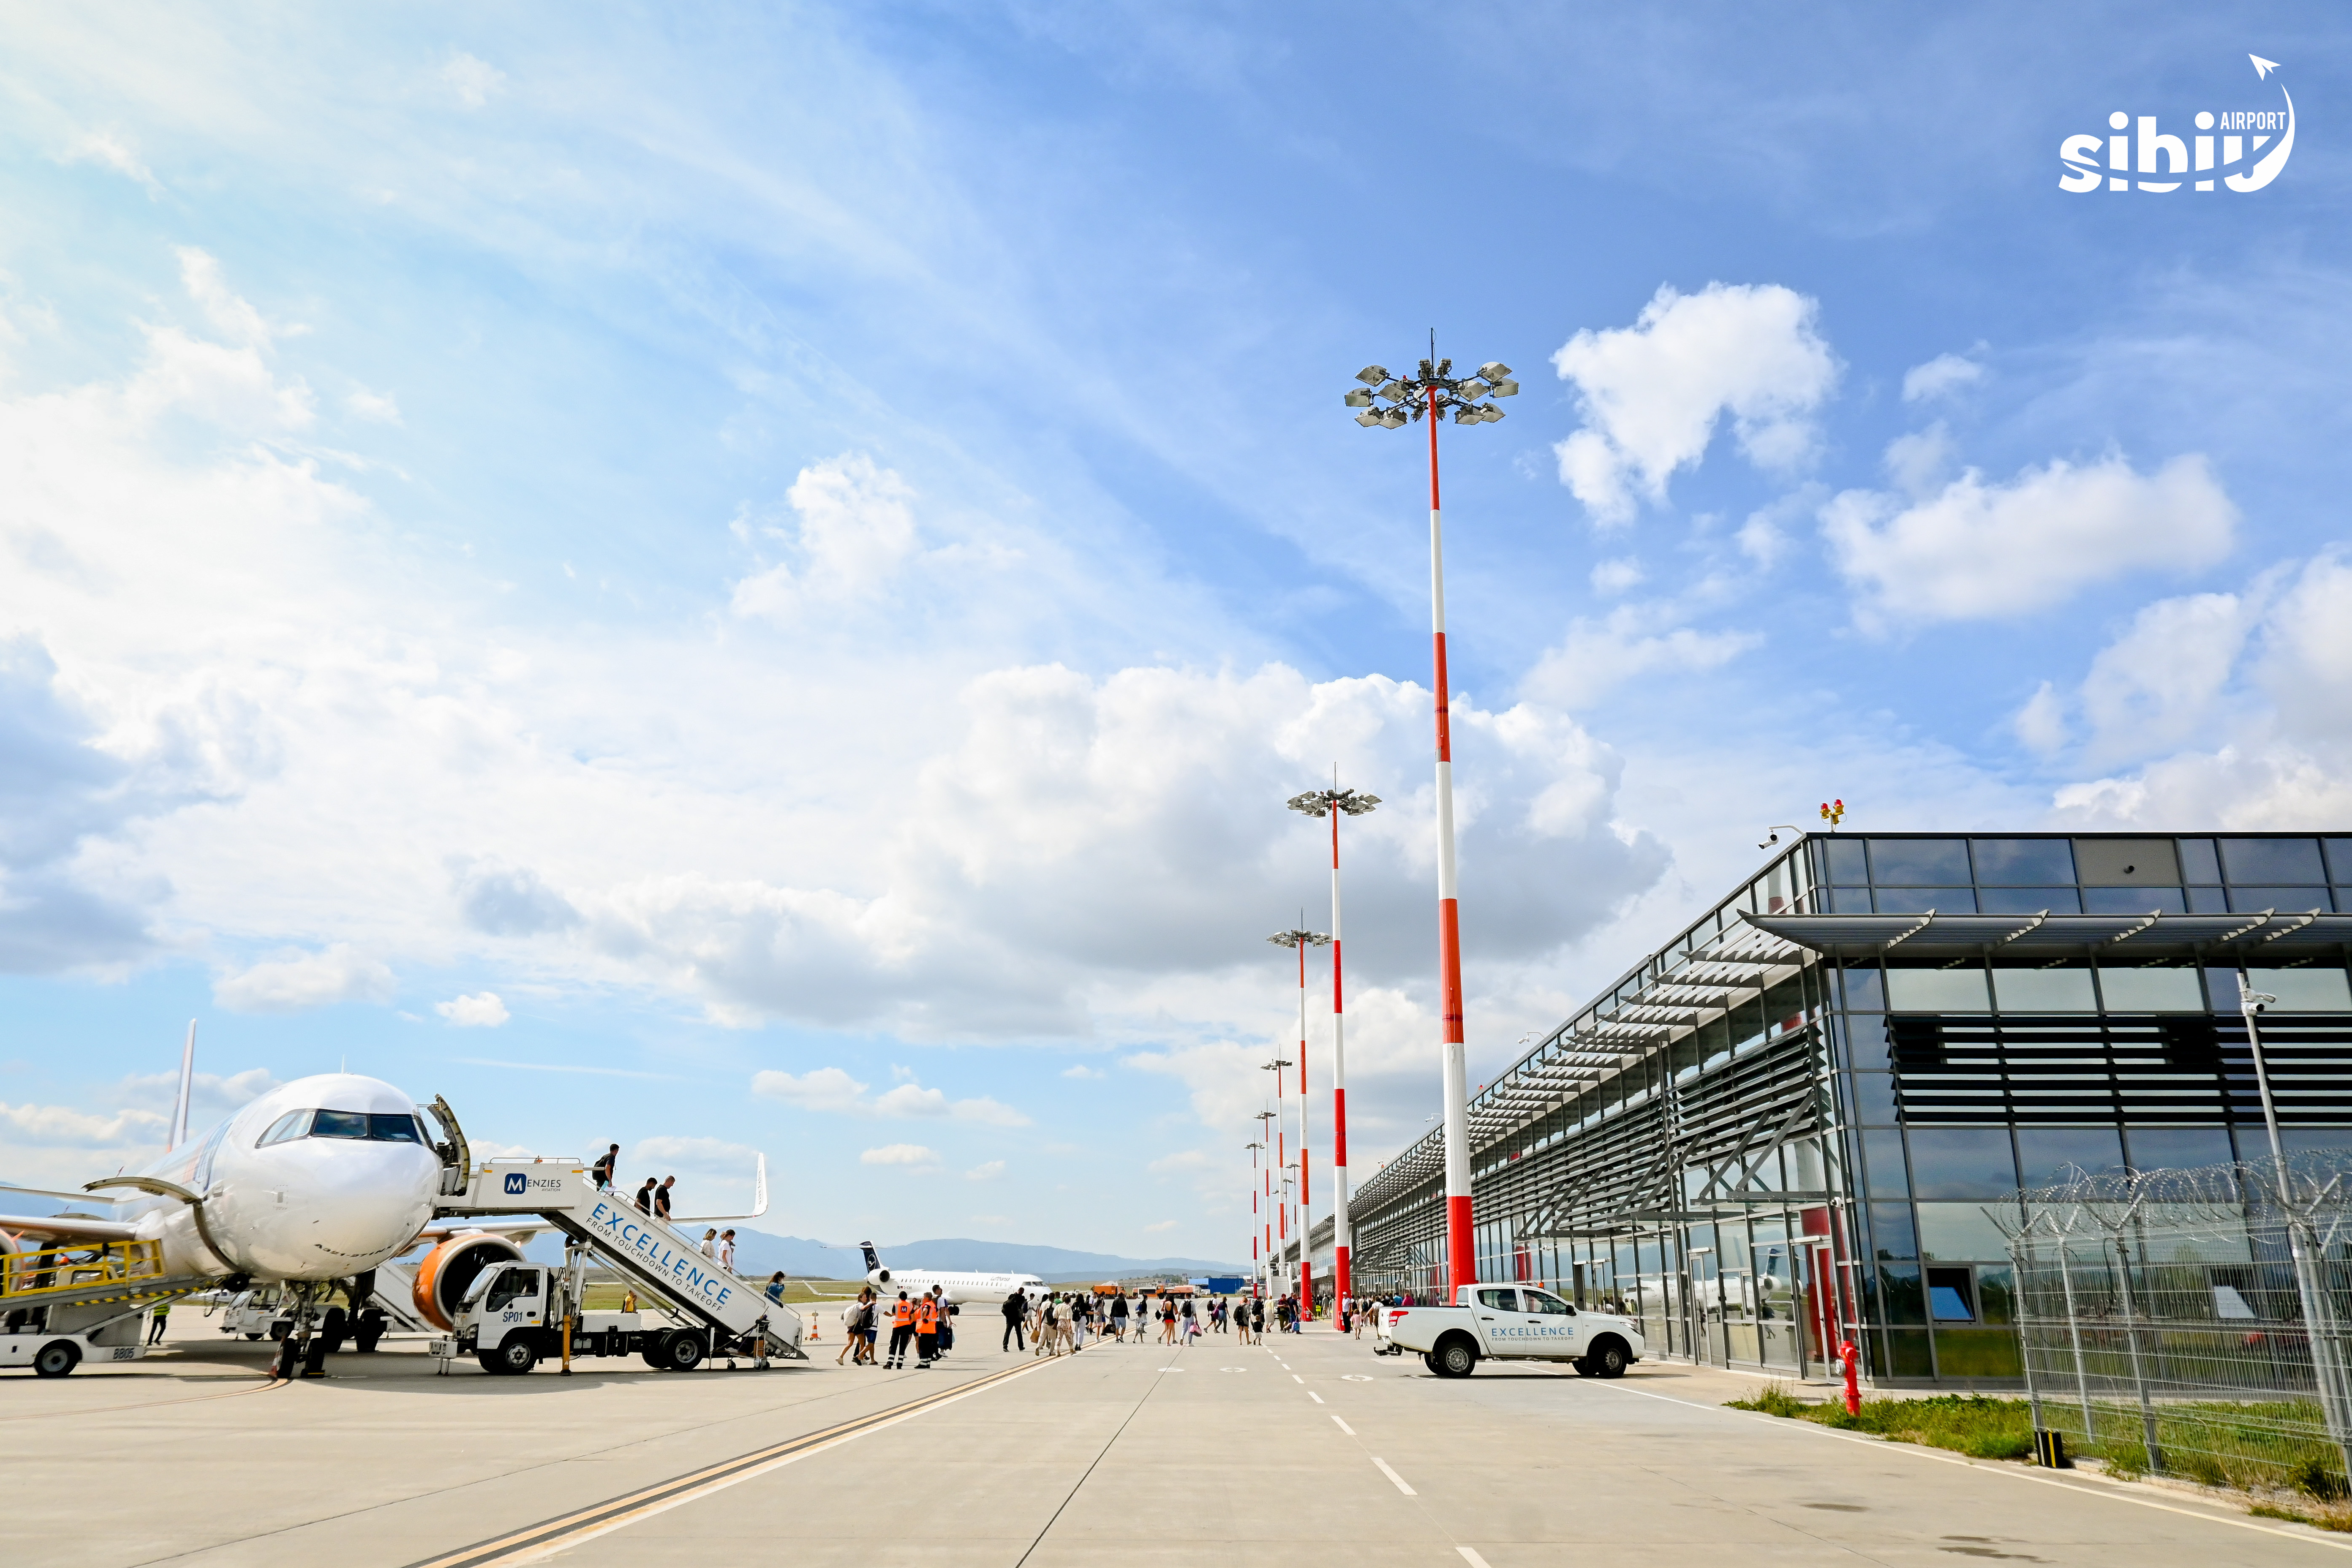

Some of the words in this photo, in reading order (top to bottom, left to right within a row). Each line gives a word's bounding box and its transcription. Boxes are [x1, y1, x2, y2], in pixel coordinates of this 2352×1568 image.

[506, 1177, 561, 1191] MENZIES
[591, 1203, 732, 1305] EXCELLENCE
[586, 1217, 611, 1238] FROM
[614, 1236, 669, 1277] TOUCHDOWN
[671, 1275, 682, 1285] TO
[685, 1284, 722, 1312] TAKEOFF
[503, 1312, 523, 1322] SP01
[1492, 1327, 1573, 1336] EXCELLENCE
